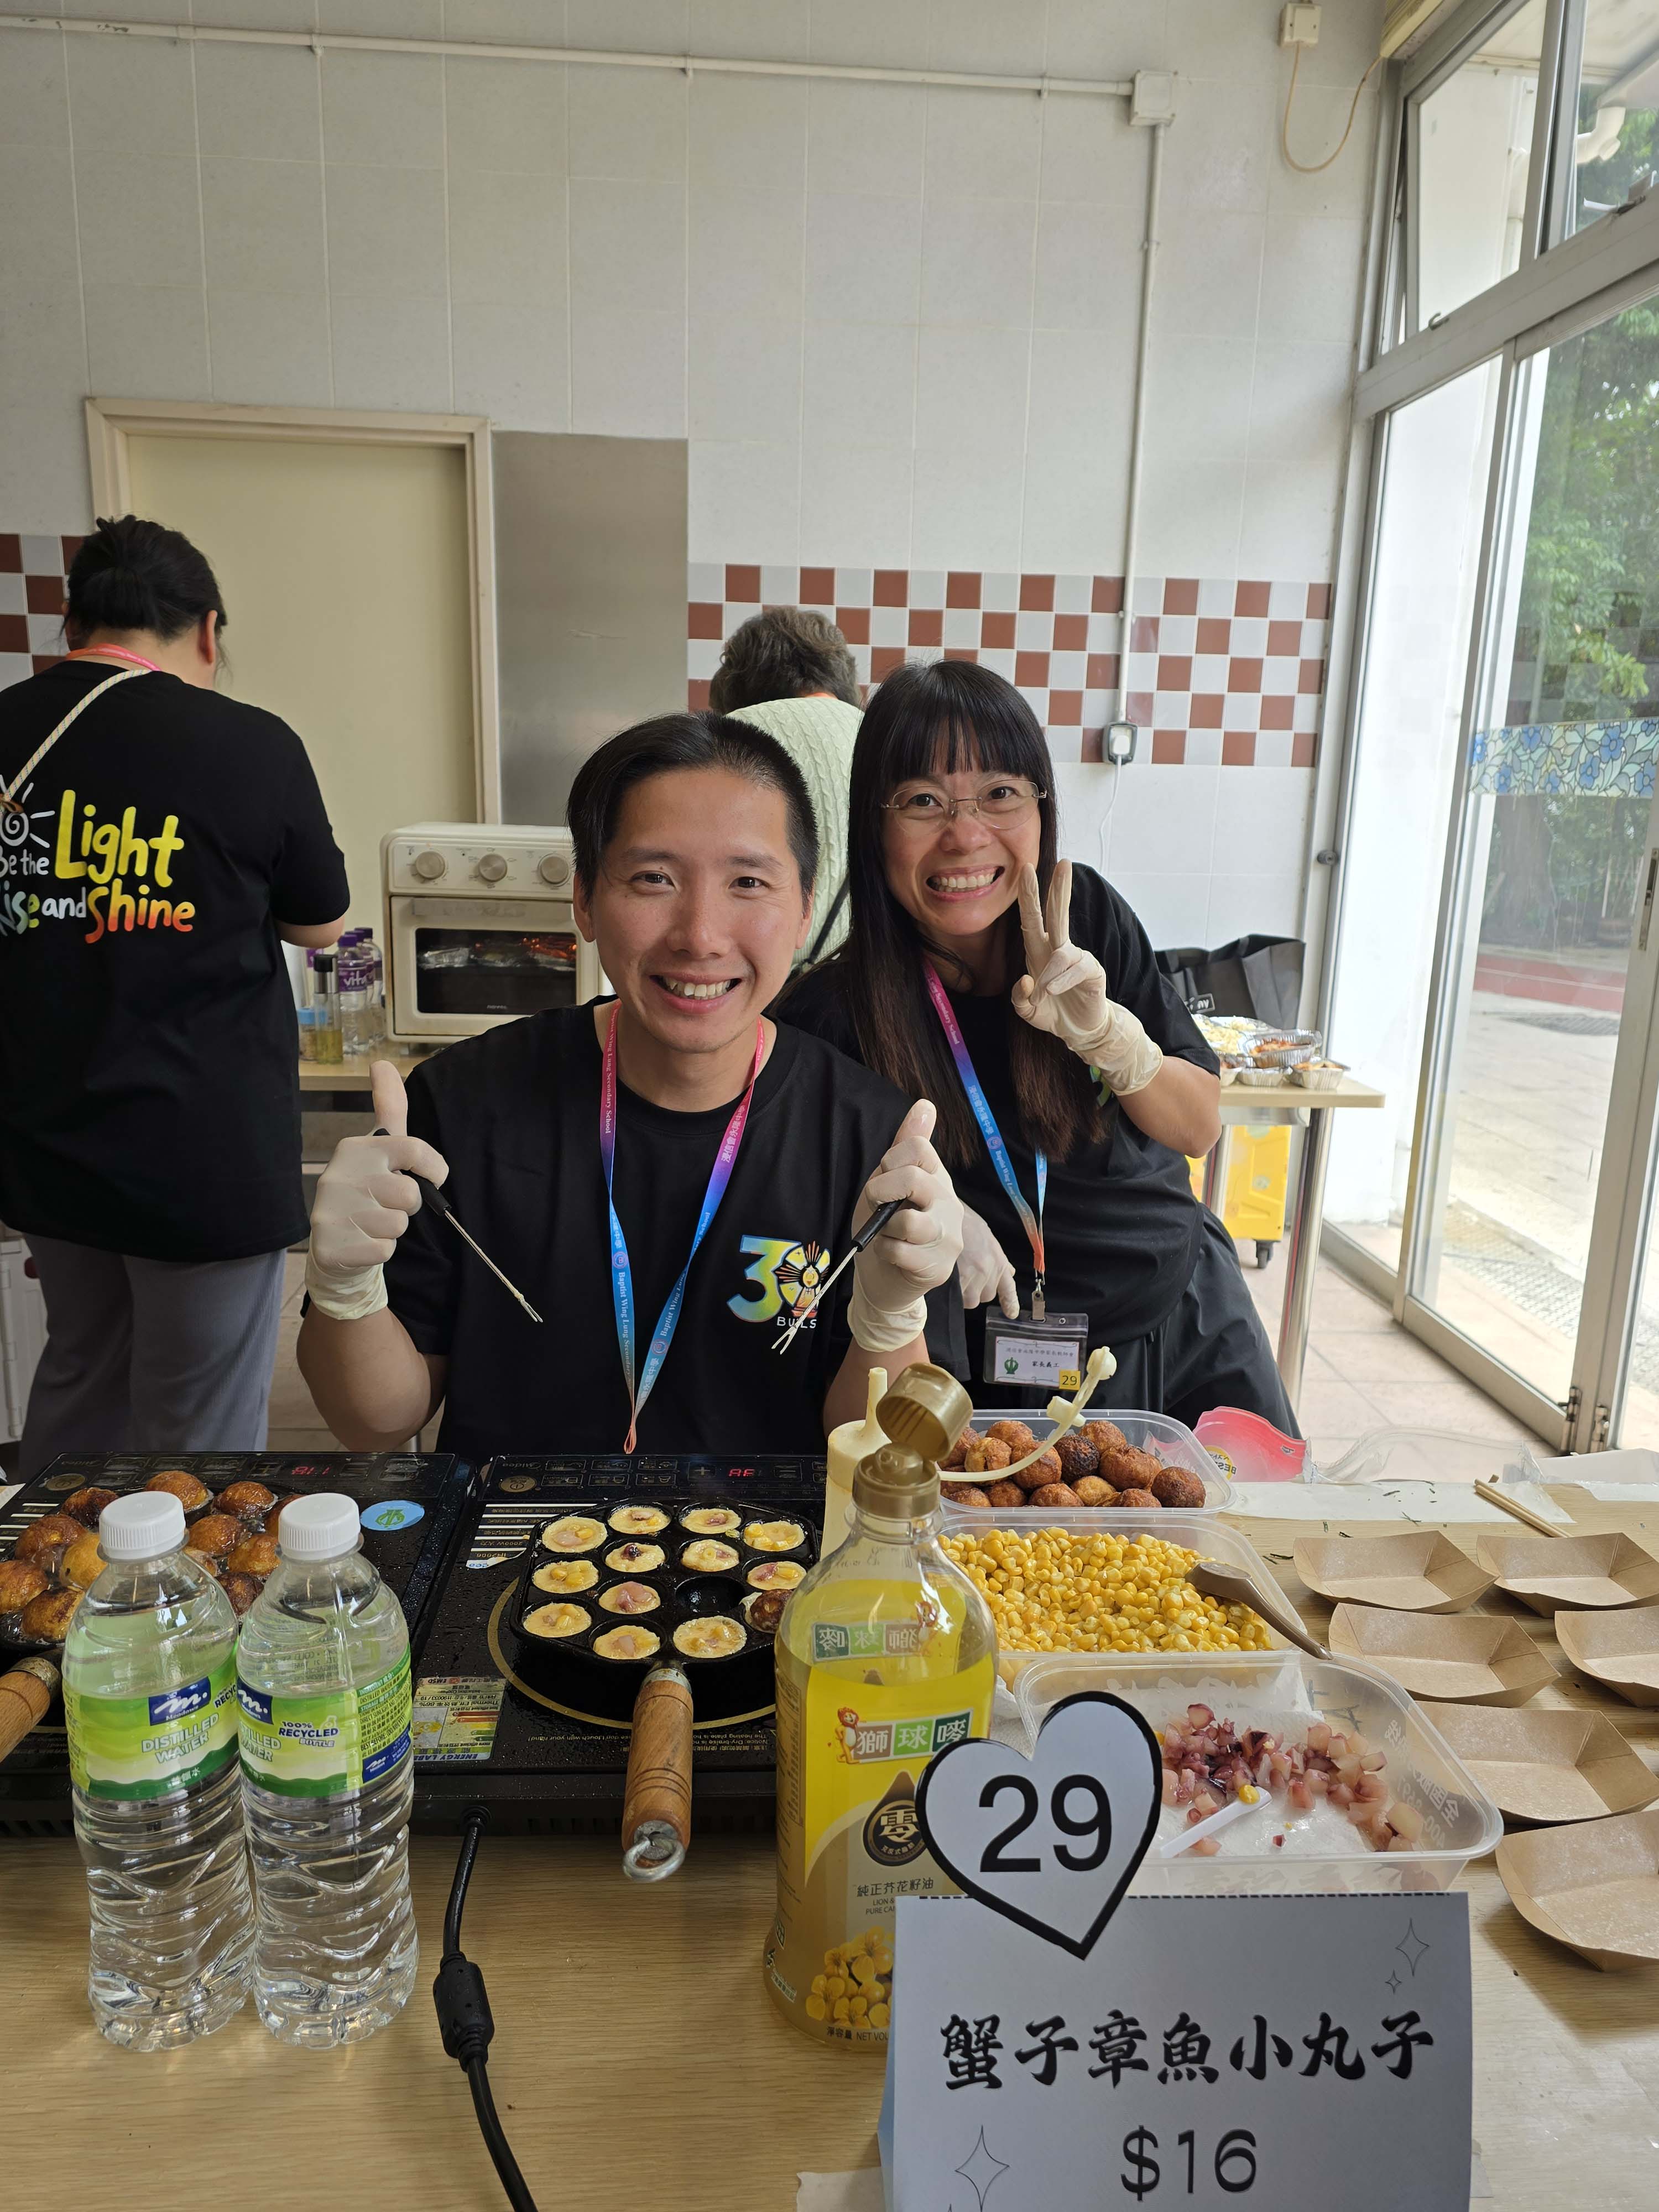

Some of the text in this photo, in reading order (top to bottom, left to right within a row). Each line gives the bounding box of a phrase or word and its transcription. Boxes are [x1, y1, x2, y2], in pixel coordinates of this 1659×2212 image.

[20, 849, 49, 875] the
[55, 790, 185, 887] Light
[0, 878, 196, 943] ise and Shine
[948, 1024, 960, 1045] School
[617, 1271, 627, 1297] Baptist
[620, 1298, 629, 1318] Wing
[660, 1312, 674, 1337] Baptist
[669, 1292, 680, 1311] Wing
[622, 1319, 631, 1339] Lung
[776, 1316, 817, 1329] BULS
[1062, 1375, 1077, 1385] 29
[214, 1685, 237, 1708] RECYC
[361, 1691, 380, 1704] DISTILLED
[142, 1713, 220, 1752] DISTILLED
[279, 1728, 339, 1738] RECYCLED
[299, 1737, 335, 1747] BOTTLE
[857, 1719, 967, 1755] 獅球嘜
[155, 1731, 209, 1764] WATER
[879, 1809, 920, 1843] 零
[978, 1773, 1112, 1872] 29
[857, 1877, 934, 1897] 純正芥花籽油
[827, 2026, 852, 2040] 淨容量
[856, 2032, 872, 2041] NET
[940, 2008, 1434, 2089] 蟹子章魚小丸子
[1120, 2125, 1258, 2201] $16
